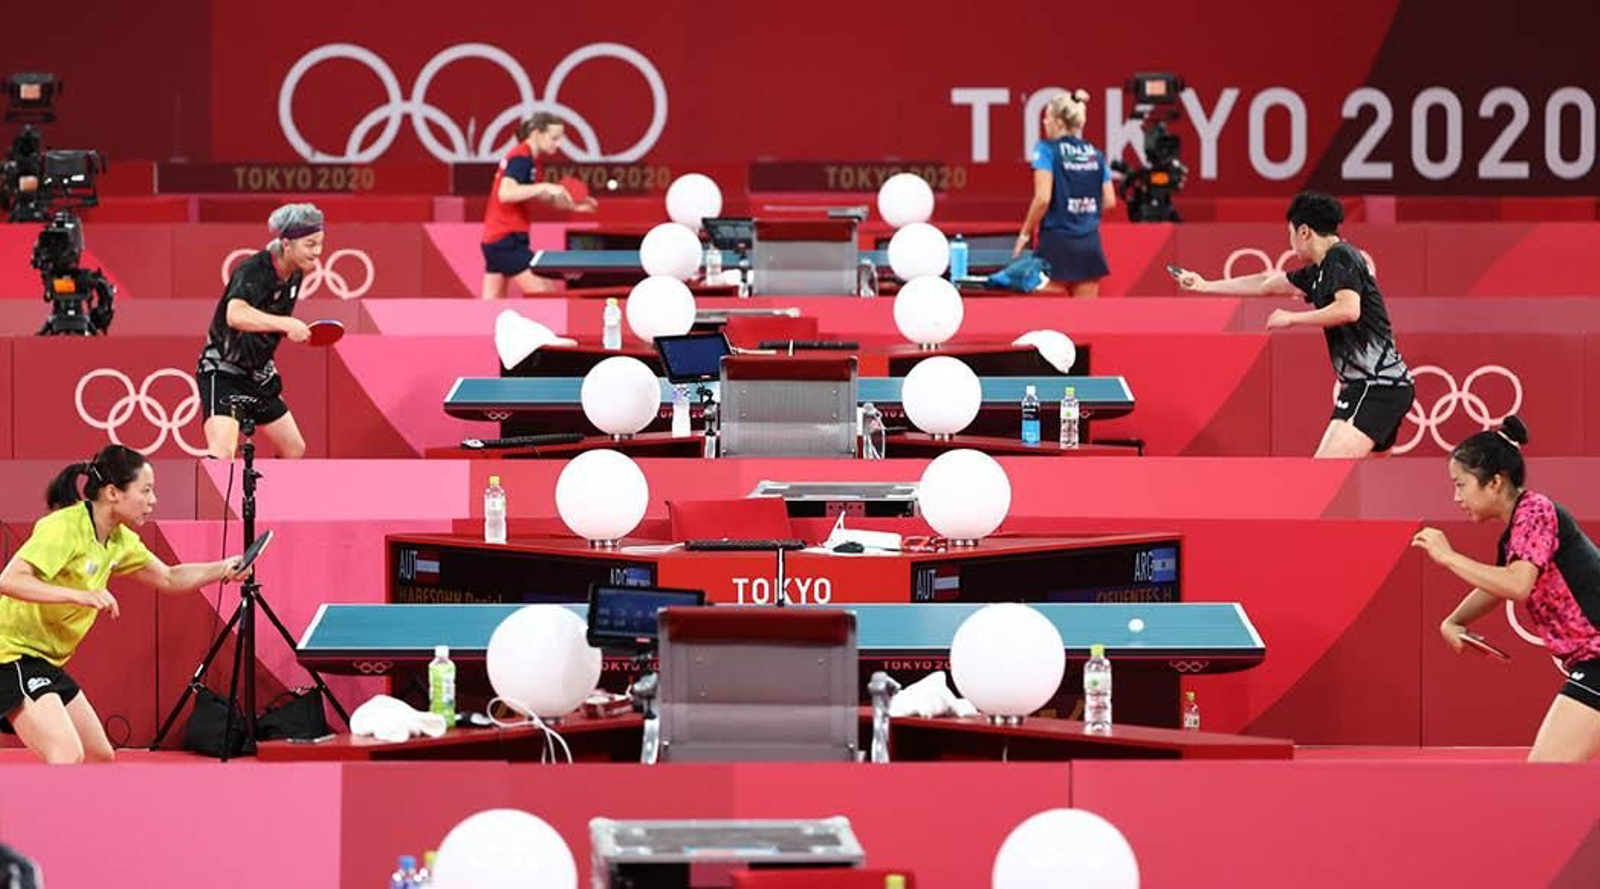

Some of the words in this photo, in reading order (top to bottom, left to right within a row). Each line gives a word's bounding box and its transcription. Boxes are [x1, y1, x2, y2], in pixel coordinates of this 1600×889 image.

[1341, 86, 1596, 180] 2020
[234, 167, 312, 190] TOKYO
[318, 167, 375, 190] 2020
[545, 166, 607, 188] OKYO
[399, 549, 417, 580] AUT
[732, 577, 831, 605] TOKYO
[916, 569, 936, 600] AUT
[602, 661, 640, 671] OKYO
[883, 660, 933, 670] TOKYO
